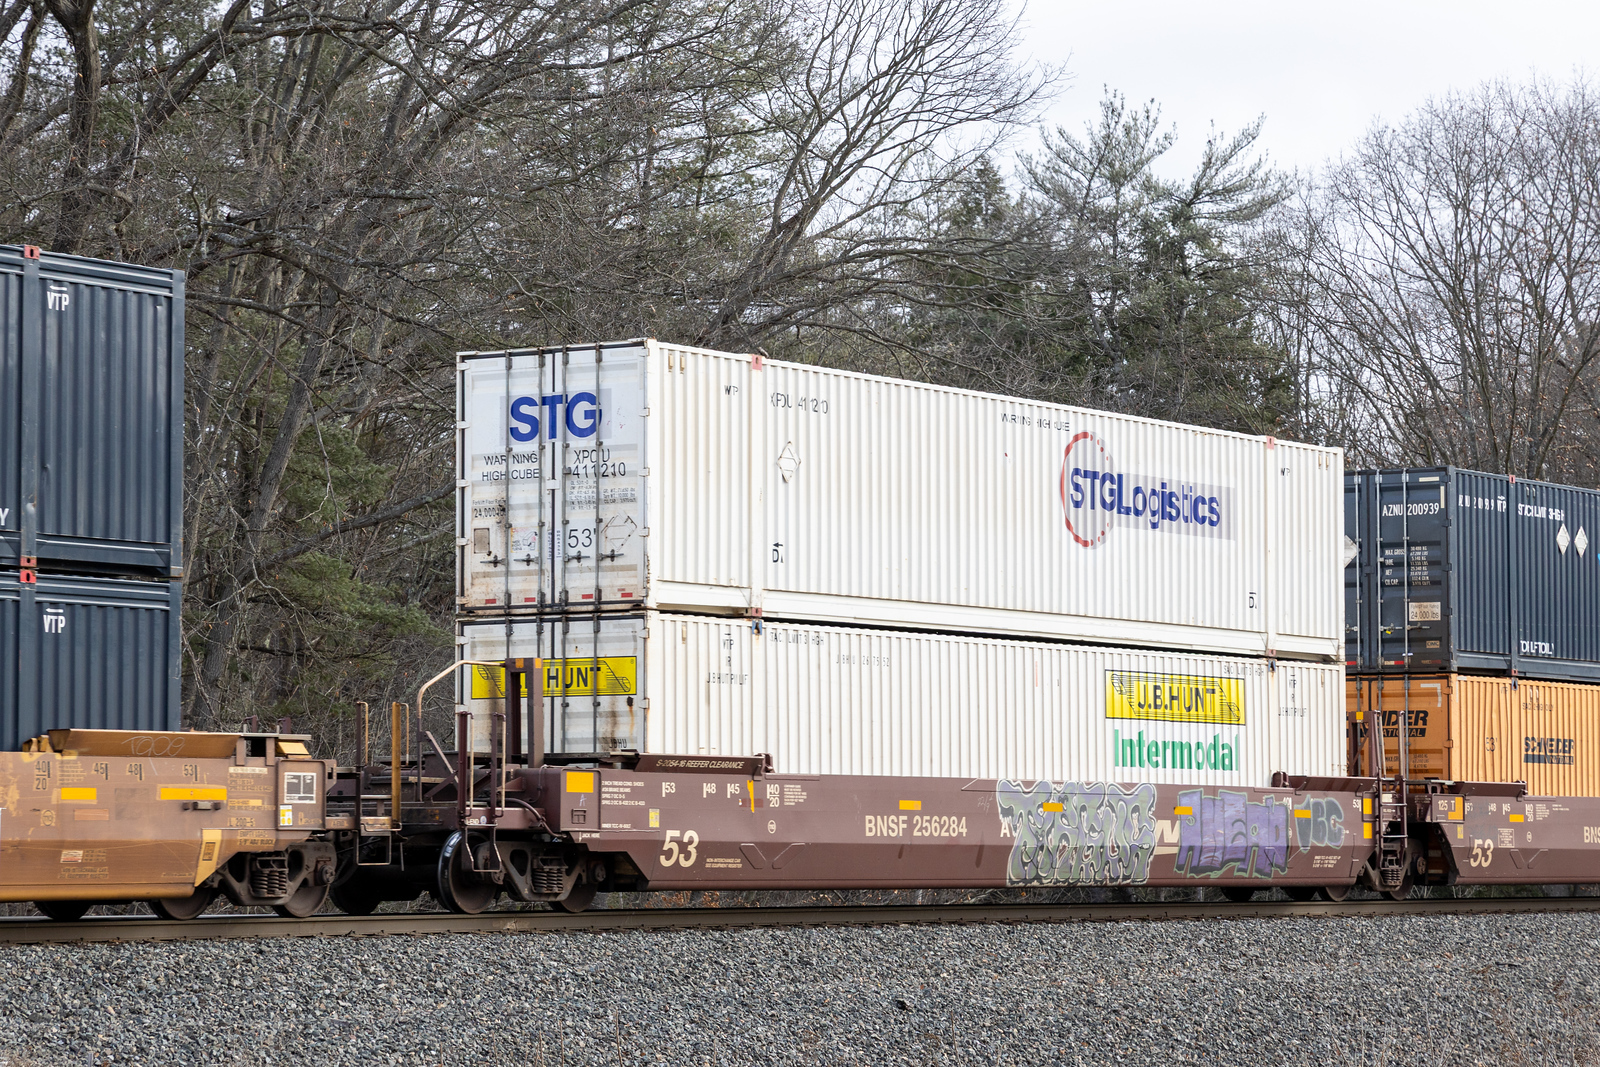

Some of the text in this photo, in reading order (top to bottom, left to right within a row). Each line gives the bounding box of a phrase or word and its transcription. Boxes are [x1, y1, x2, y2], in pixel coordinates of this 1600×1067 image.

[47, 291, 69, 311] VTP
[509, 391, 603, 442] STG
[511, 468, 540, 480] CUBE
[1382, 502, 1440, 517] AZNU 200939
[43, 614, 66, 634] VTP
[1114, 729, 1239, 771] Intermodal
[35, 760, 47, 773] 40
[93, 762, 106, 775] 45
[128, 763, 139, 776] 48
[183, 764, 195, 777] 53
[35, 777, 47, 790] 20
[665, 782, 676, 793] 53
[706, 783, 717, 794] 48
[730, 783, 741, 794] 45
[769, 784, 780, 794] 40
[769, 797, 780, 807] 20
[865, 815, 968, 837] BNSF 256284
[659, 829, 700, 868] 53
[1470, 838, 1494, 868] 53
